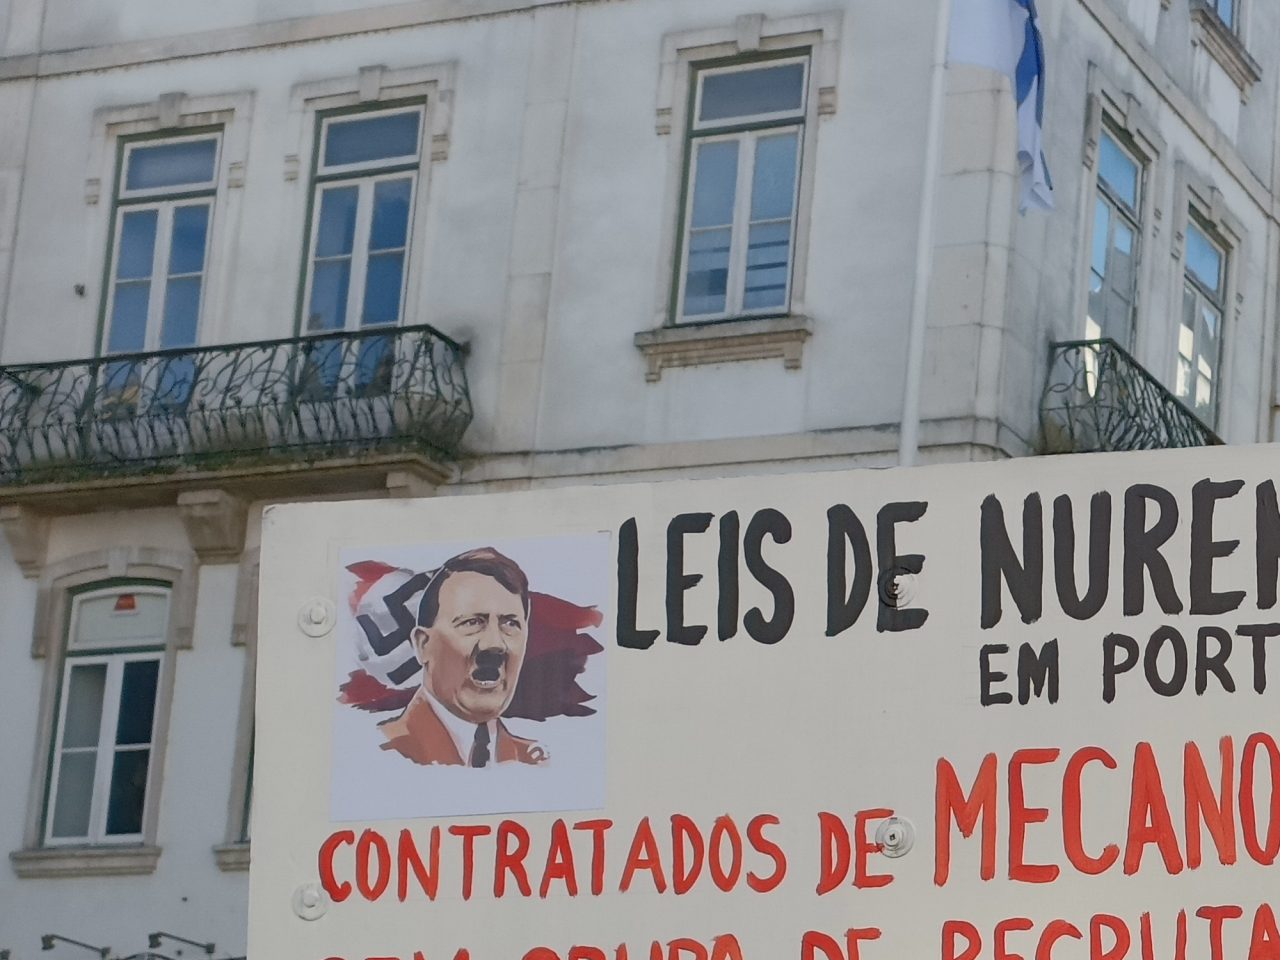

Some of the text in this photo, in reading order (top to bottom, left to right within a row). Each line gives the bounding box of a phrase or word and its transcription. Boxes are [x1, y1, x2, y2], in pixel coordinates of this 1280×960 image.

[617, 508, 795, 649] LEIS
[825, 501, 929, 636] DE
[980, 638, 1060, 706] EM
[318, 813, 787, 903] CONTRATADOS
[816, 808, 896, 896] DE
